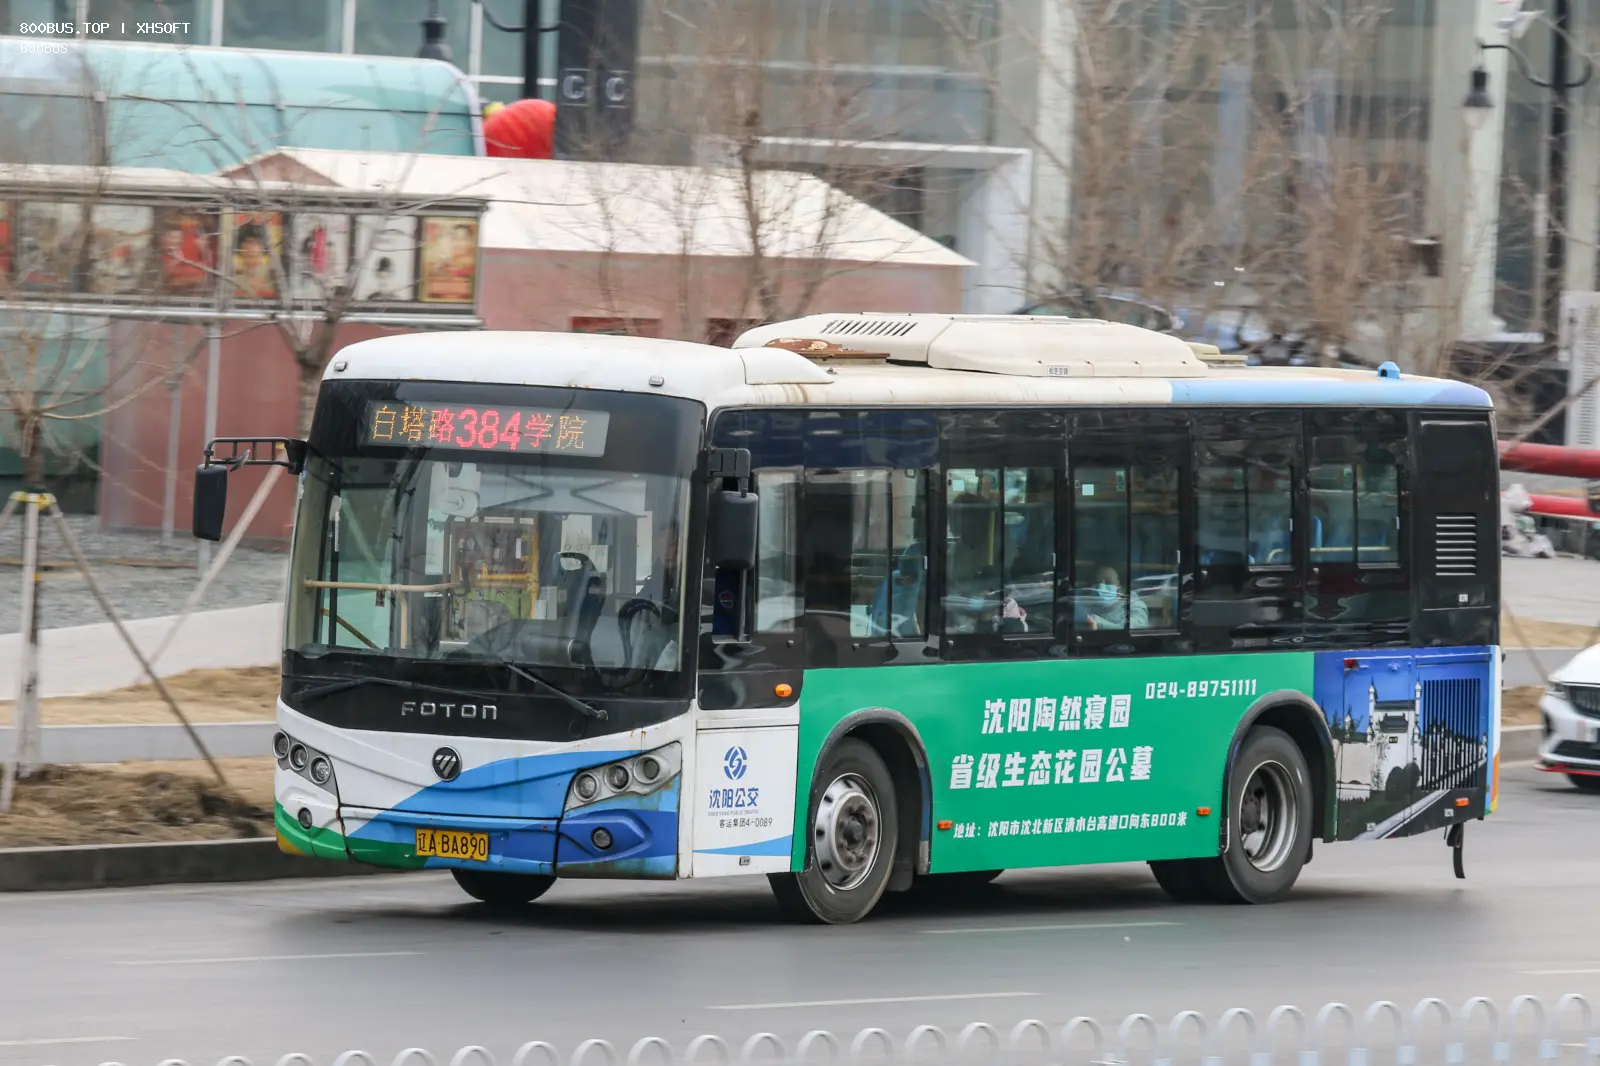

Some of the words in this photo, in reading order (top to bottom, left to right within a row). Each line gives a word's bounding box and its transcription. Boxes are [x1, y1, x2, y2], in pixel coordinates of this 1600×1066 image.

[1145, 679, 1257, 700] 024-89751111
[401, 701, 498, 720] FOTON
[981, 694, 1132, 735] 沈阳陶然寝园
[949, 746, 1154, 790] 省级生态花园公墓
[708, 787, 759, 809] 沈阳公交
